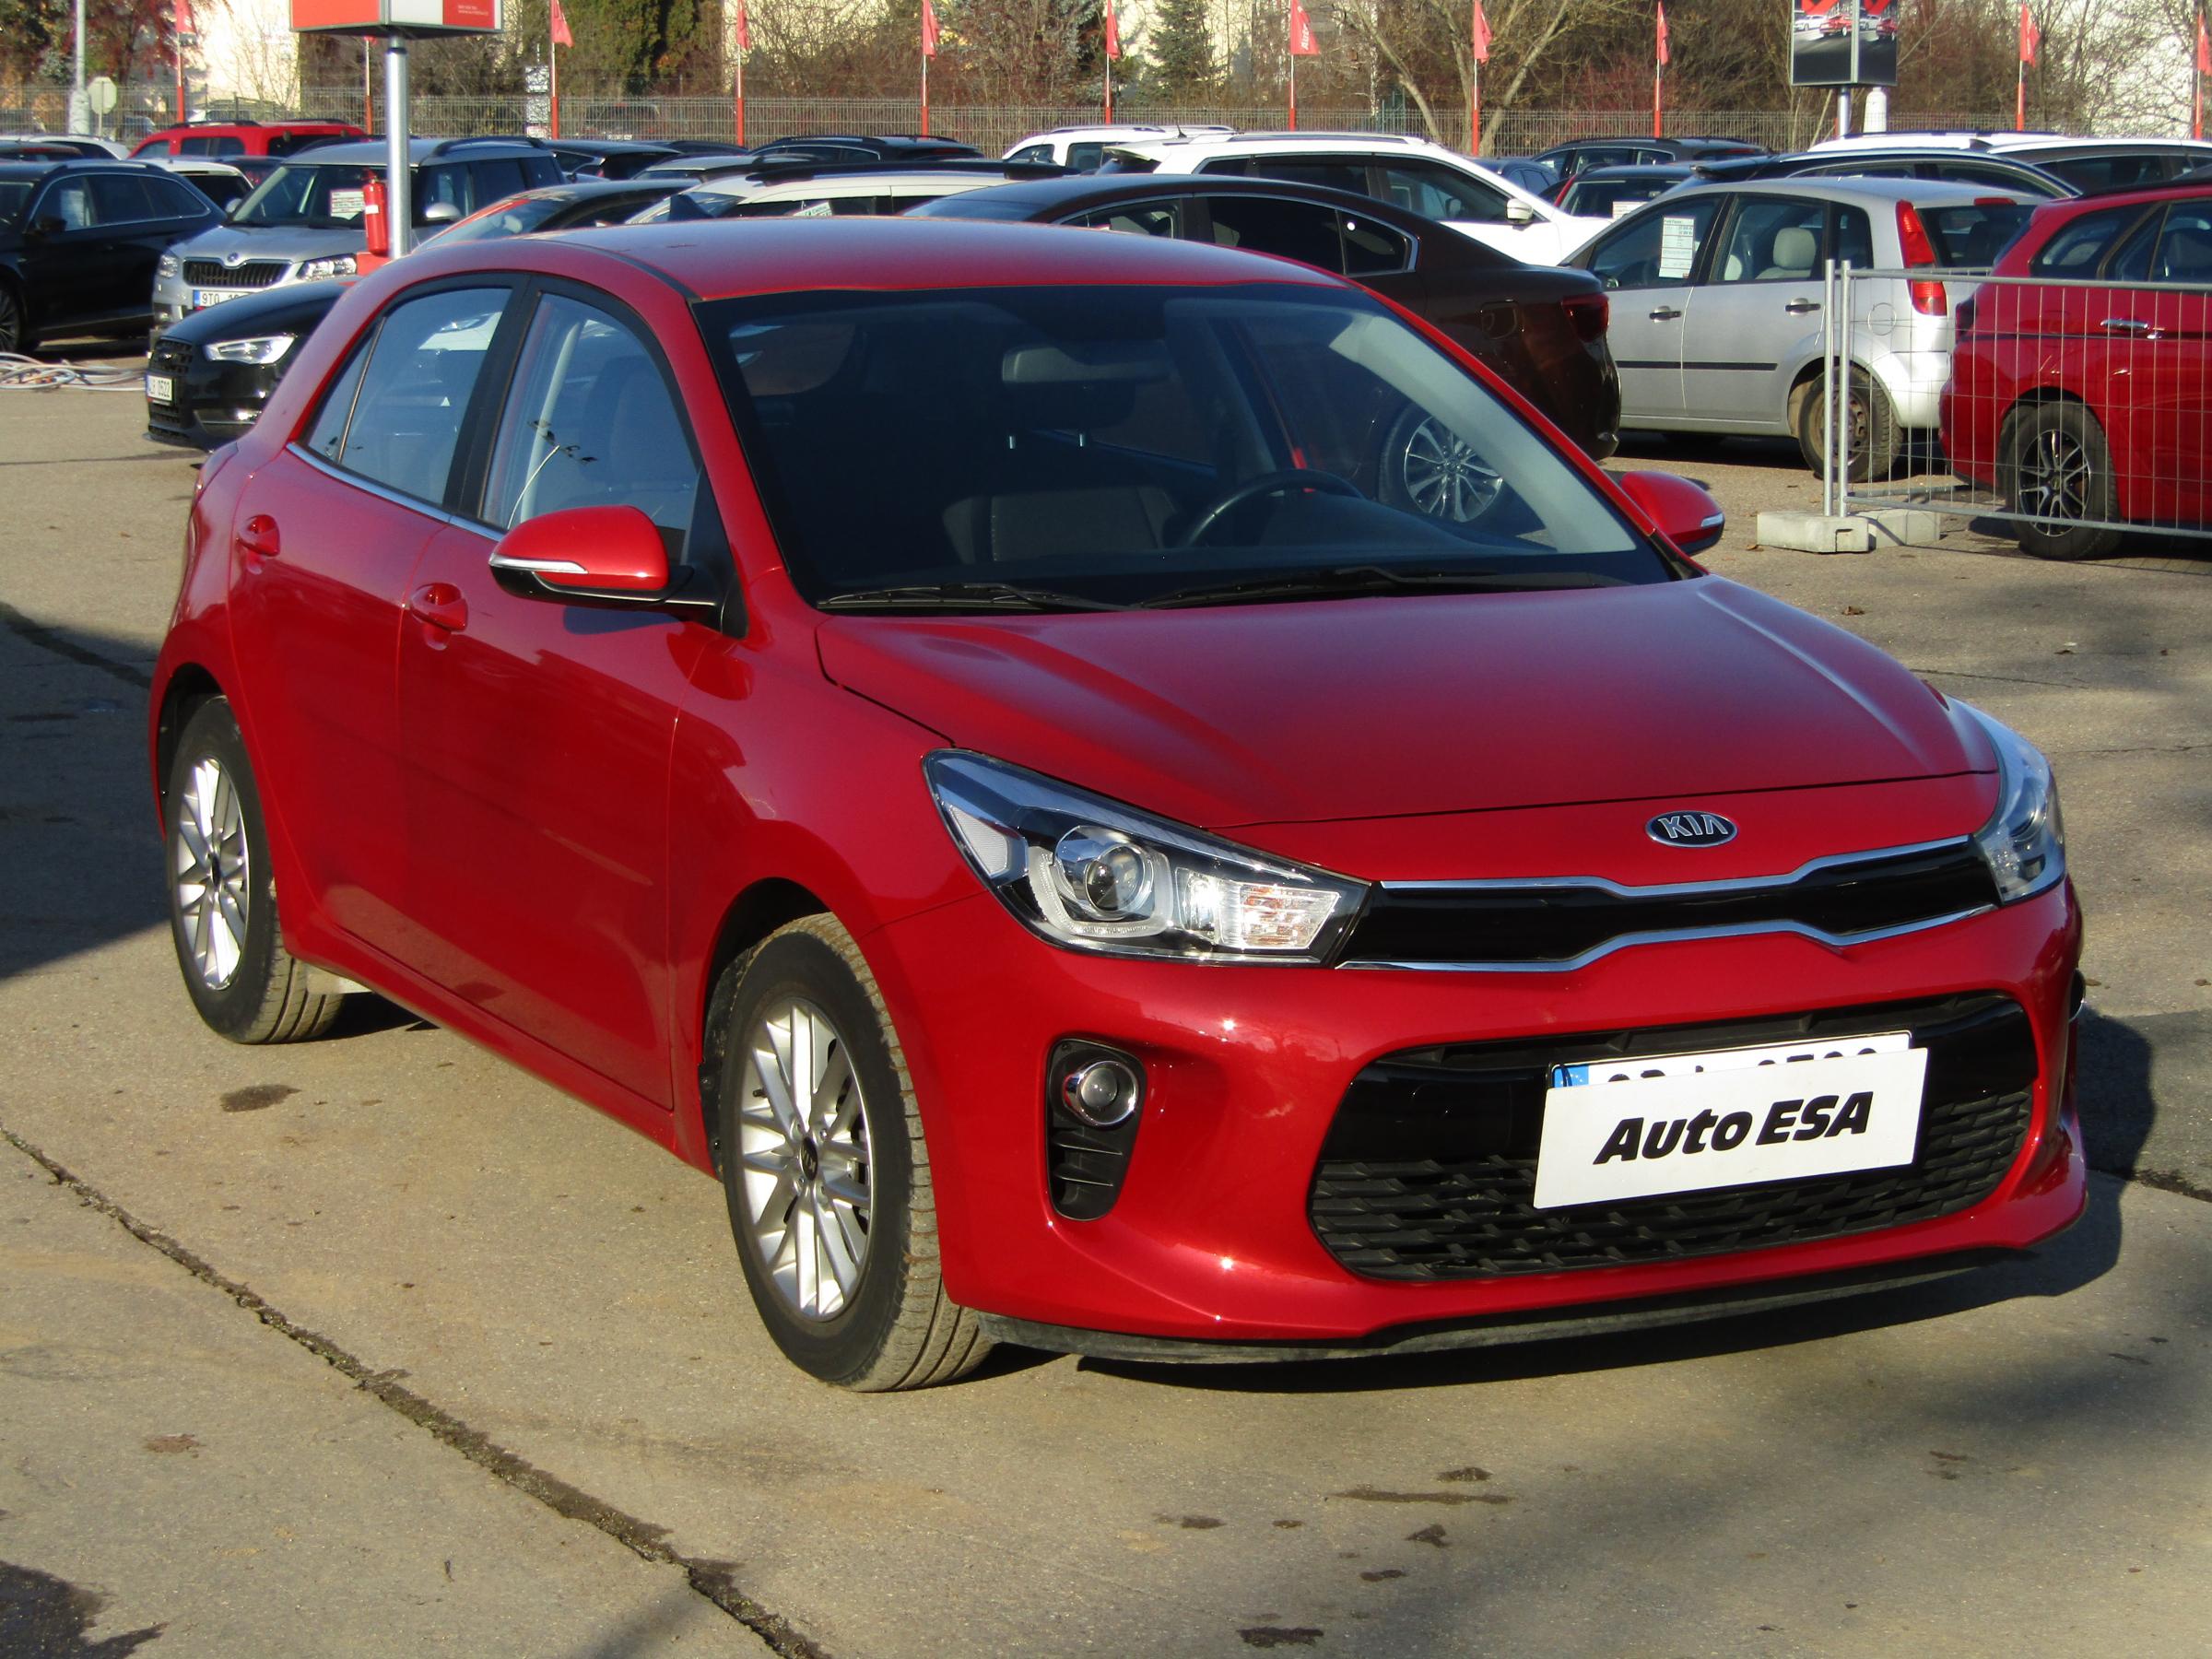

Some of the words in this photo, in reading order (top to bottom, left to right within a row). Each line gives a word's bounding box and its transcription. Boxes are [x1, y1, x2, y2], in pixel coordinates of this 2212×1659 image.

[1657, 814, 1729, 839] KIA
[1593, 1109, 1753, 1165] Auto
[1756, 1091, 1874, 1147] ESA
